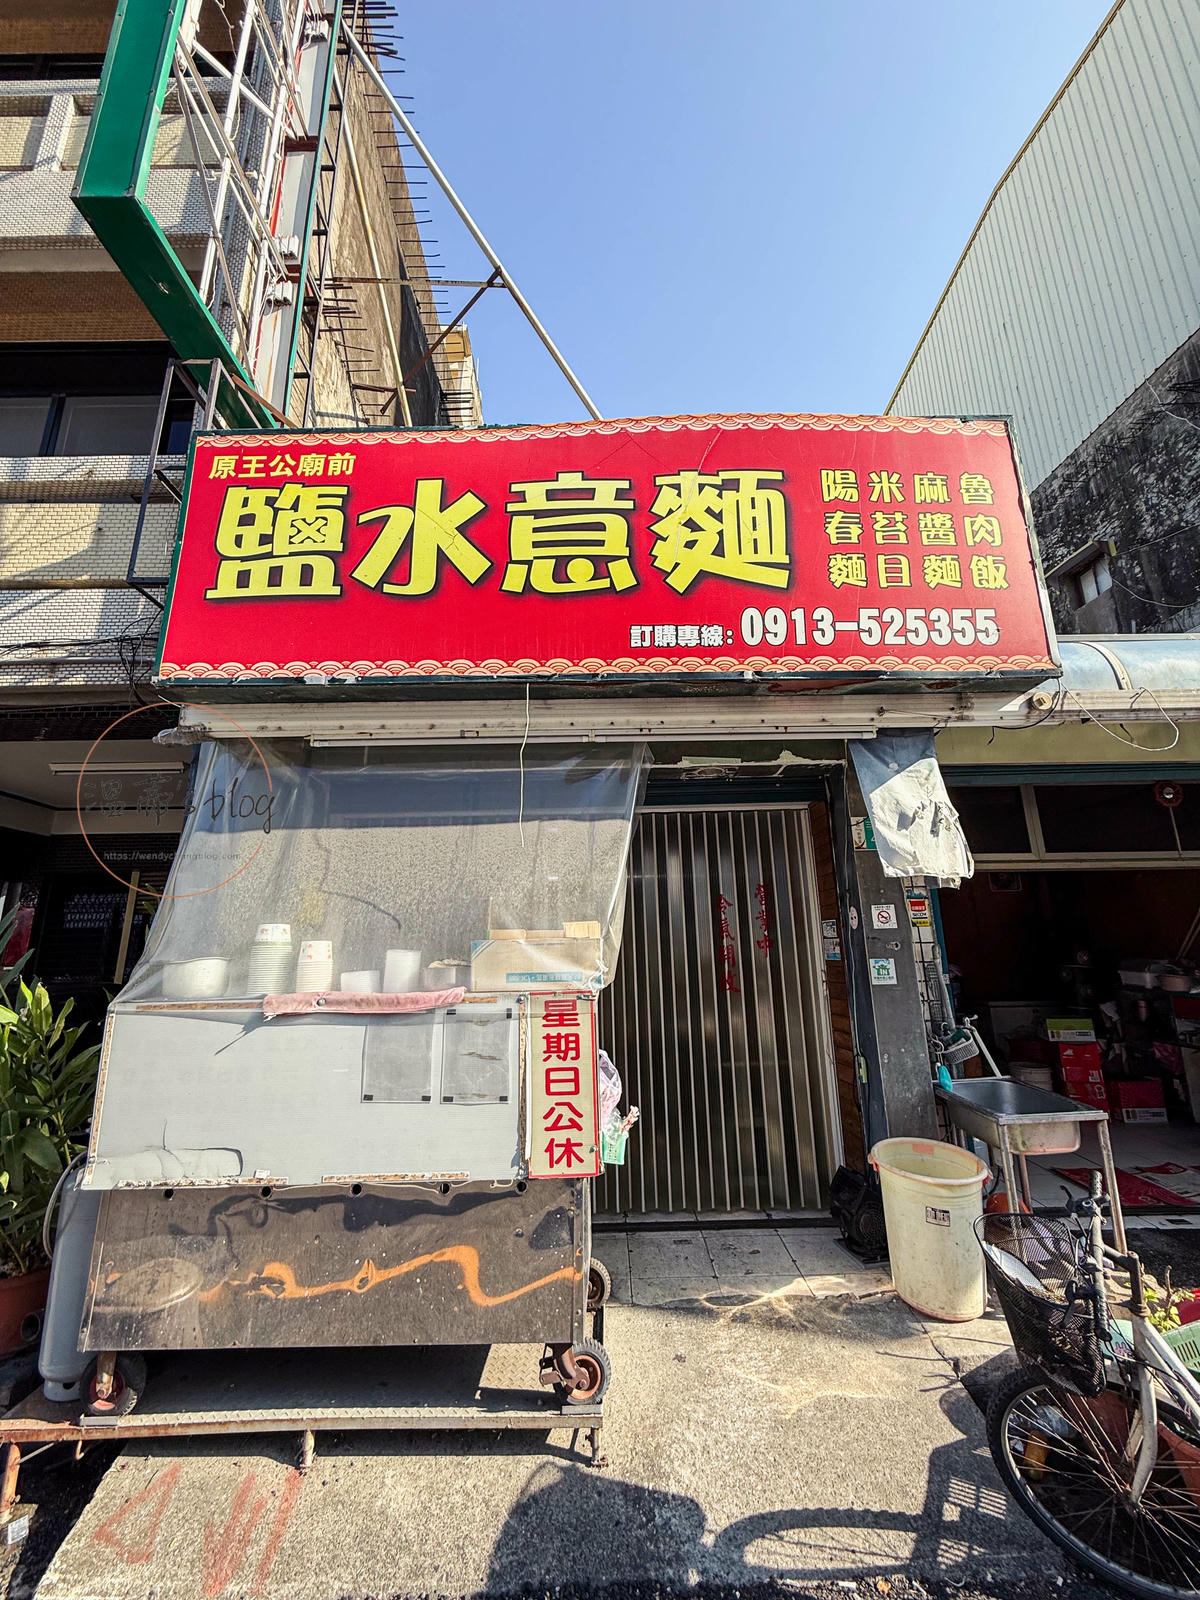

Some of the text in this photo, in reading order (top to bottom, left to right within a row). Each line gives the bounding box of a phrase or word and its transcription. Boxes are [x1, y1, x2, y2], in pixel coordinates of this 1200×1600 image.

[208, 452, 357, 480] 原王公廟前
[204, 469, 792, 596] 鹽水意麵
[820, 468, 868, 589] 陽春麵
[868, 470, 912, 589] 米苔目
[913, 471, 963, 590] 麻醬麵
[958, 471, 1009, 591] 魯肉飯
[630, 606, 1001, 649] 訂購專線: 0913-525355
[542, 999, 585, 1168] 星期日公休
